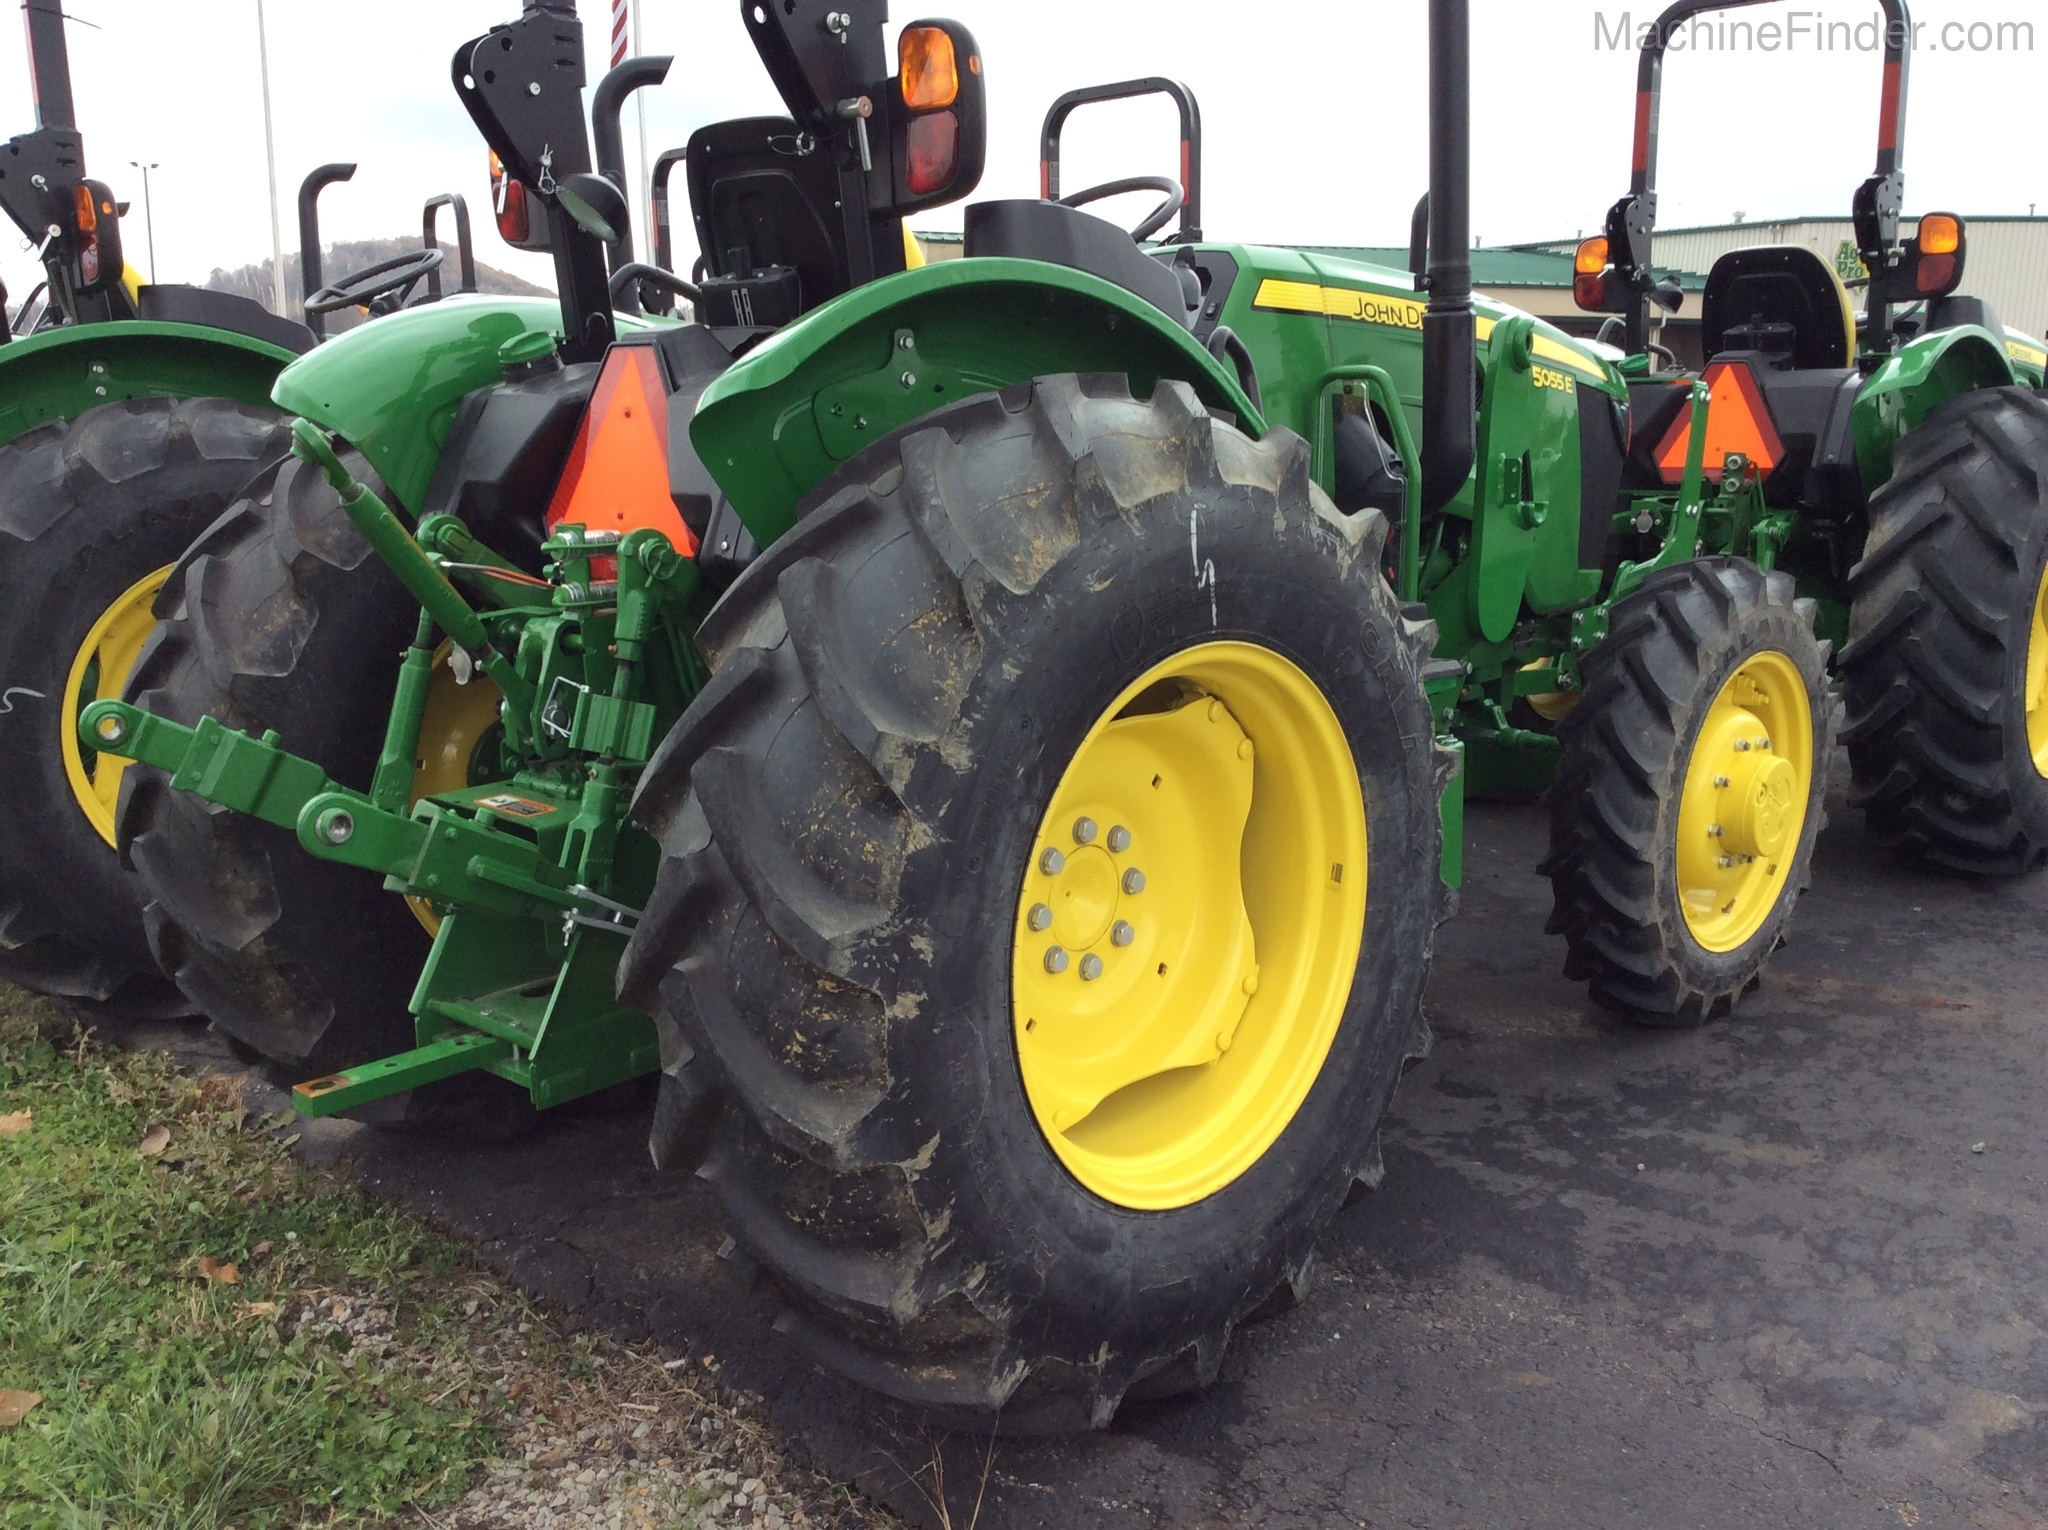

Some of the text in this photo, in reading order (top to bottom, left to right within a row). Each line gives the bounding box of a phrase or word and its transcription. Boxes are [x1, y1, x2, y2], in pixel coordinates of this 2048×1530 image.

[1837, 242, 1858, 264] Ag
[1837, 261, 1864, 278] Pro
[1354, 297, 1402, 323] JOHN
